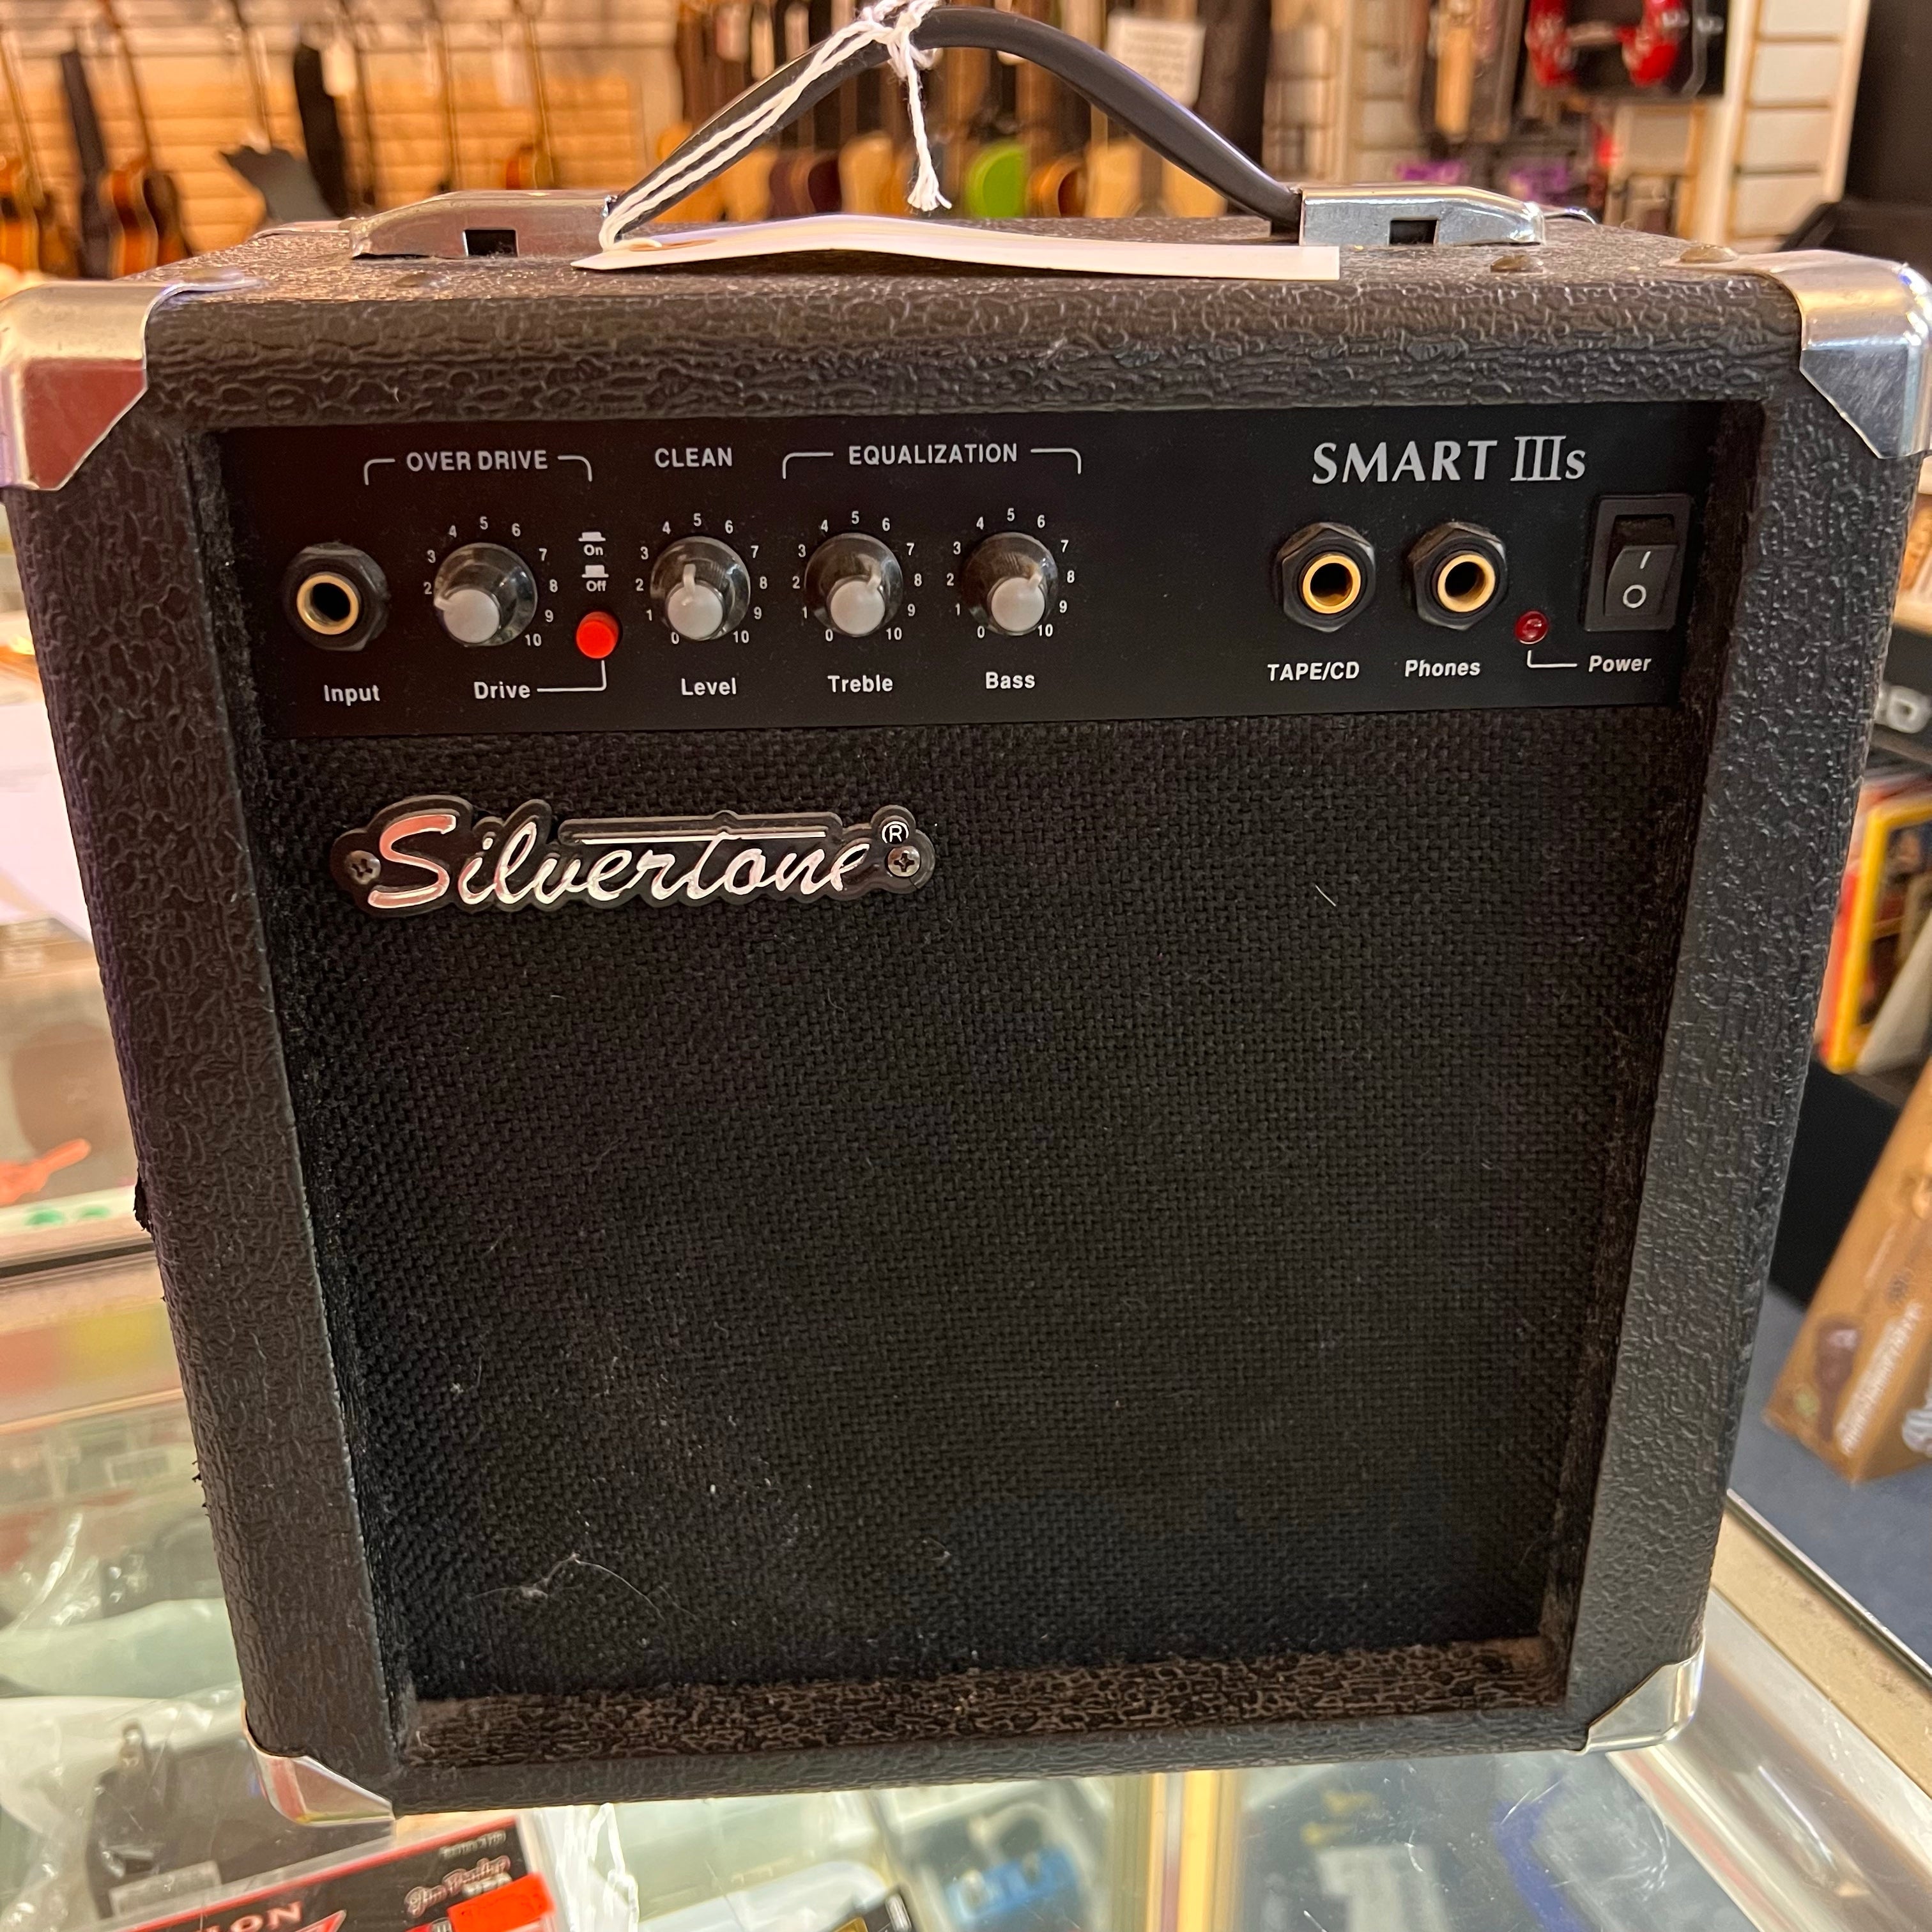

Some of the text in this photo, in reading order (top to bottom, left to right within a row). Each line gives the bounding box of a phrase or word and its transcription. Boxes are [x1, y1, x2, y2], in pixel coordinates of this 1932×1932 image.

[406, 450, 548, 472] OVER DRIVE
[655, 447, 732, 468] CLEAN
[848, 443, 1017, 465] EQUALIZATION
[1312, 440, 1498, 484] SMART
[693, 512, 702, 527] 5
[851, 510, 859, 525] 5
[1007, 507, 1015, 522] 5
[1037, 514, 1045, 528] 6
[662, 521, 671, 535] 4
[724, 519, 733, 534] 6
[820, 519, 829, 532] 4
[882, 518, 891, 532] 6
[976, 516, 984, 530] 4
[583, 544, 604, 556] On
[640, 546, 649, 560] 3
[751, 545, 759, 558] 7
[798, 544, 806, 558] 3
[906, 542, 915, 556] 7
[953, 541, 961, 555] 3
[1061, 539, 1069, 553] 7
[423, 516, 558, 647] 2 3 4 5 6 7 8 9 10
[759, 576, 768, 590] 8
[792, 576, 801, 589] 2
[914, 573, 923, 587] 8
[946, 572, 954, 586] 2
[1066, 570, 1075, 583] 8
[586, 580, 606, 592] Off
[635, 578, 644, 592] 2
[753, 606, 762, 620] 9
[907, 603, 916, 617] 9
[1059, 600, 1068, 613] 9
[733, 630, 749, 643] 10
[825, 628, 833, 642] 0
[885, 627, 902, 640] 10
[977, 625, 985, 638] 0
[1038, 624, 1054, 637] 10
[671, 631, 680, 645] 0
[1405, 659, 1480, 677] Phones
[1588, 655, 1652, 672] Power
[1267, 661, 1360, 682] TAPE/CD
[681, 677, 737, 696] Level
[827, 674, 893, 693] Treble
[985, 671, 1035, 689] Bass
[324, 684, 380, 707] Input
[473, 681, 530, 700] Drive
[368, 814, 870, 909] Silvertone
